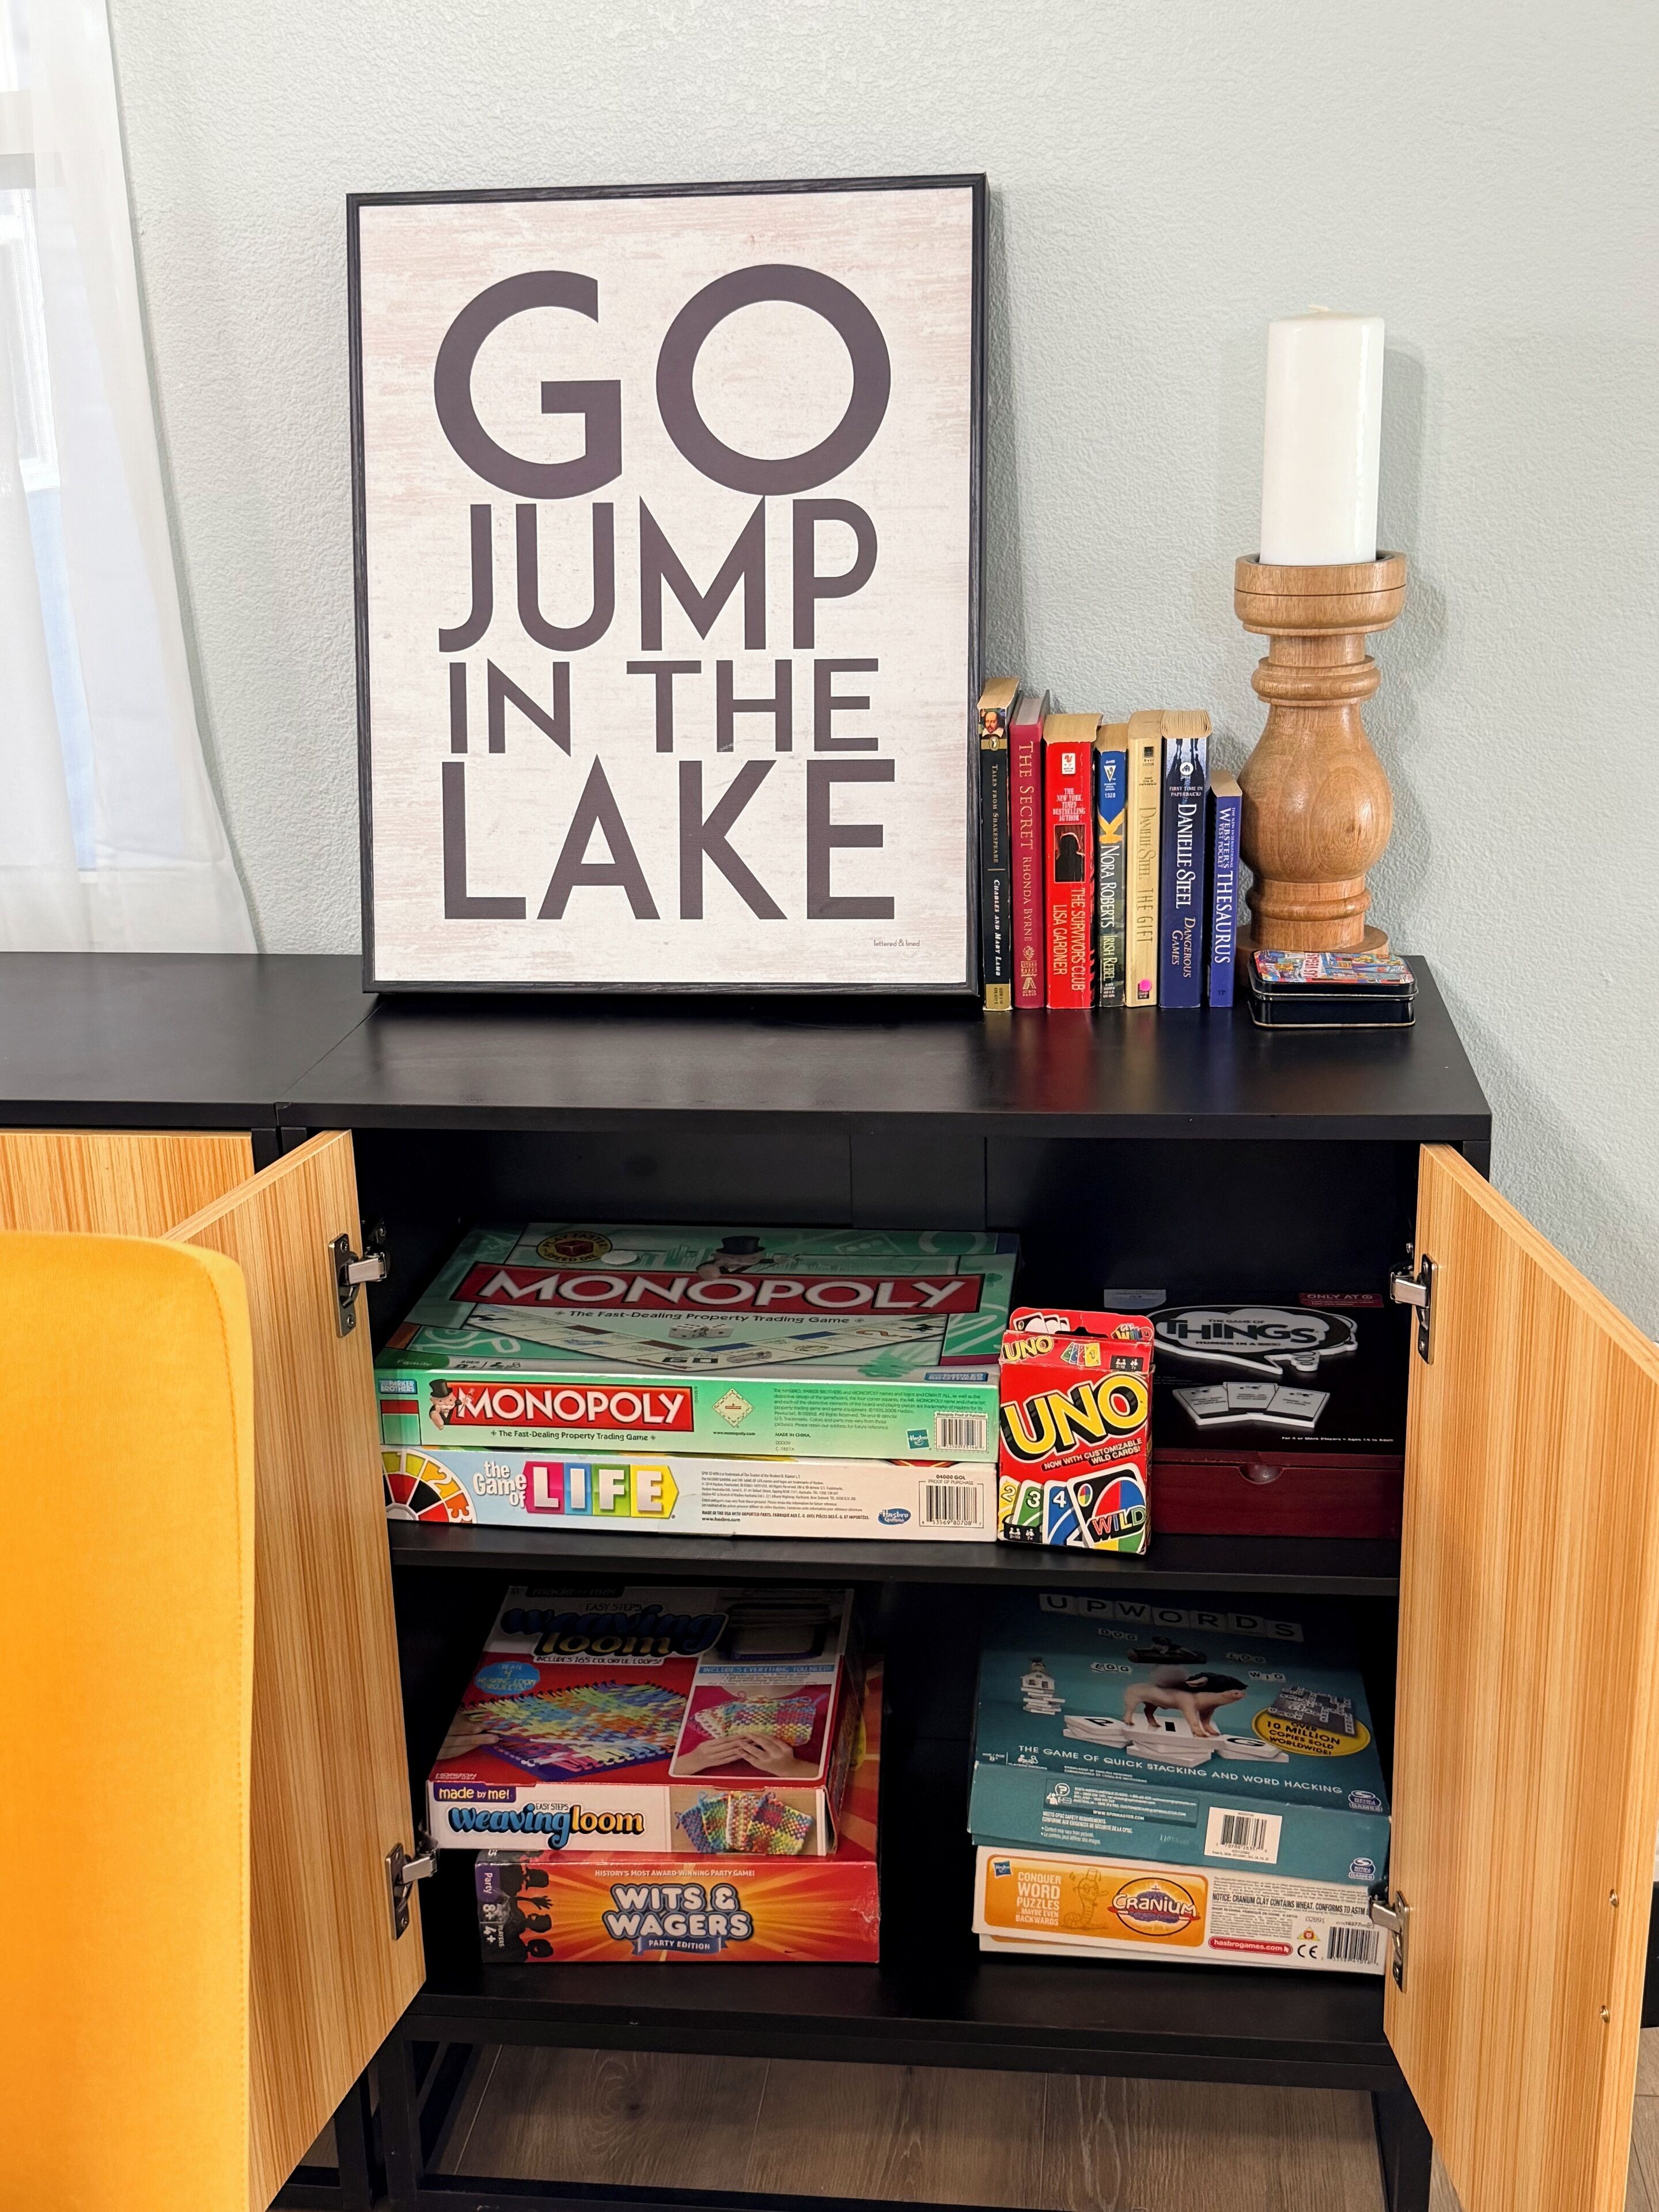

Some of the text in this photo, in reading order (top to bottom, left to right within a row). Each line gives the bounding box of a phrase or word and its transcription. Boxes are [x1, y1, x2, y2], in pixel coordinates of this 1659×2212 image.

[434, 263, 891, 501] GO
[438, 495, 878, 653] JUMP
[449, 658, 879, 757] IN THE
[1019, 741, 1034, 850] THE SECRET
[442, 755, 896, 920] LAKE
[1176, 804, 1197, 909] DANIELLE STEEL
[1100, 845, 1120, 929] NORA ROBERTS
[1215, 808, 1233, 964] WEBSTER'S THESAURUS
[1022, 856, 1033, 941] RHONDA BYRNE
[1053, 904, 1067, 975] LISA GARDNER
[1071, 888, 1086, 991] THE SURVIVORS CLUB
[1103, 935, 1117, 956] IRISH
[1172, 930, 1183, 965] GAMES
[1183, 917, 1196, 978] DANGEROUS
[1103, 957, 1117, 981] REBEL
[478, 1270, 966, 1309] MONOPOLY
[597, 1311, 682, 1320] Fast-Dealing
[685, 1312, 749, 1323] Property
[752, 1315, 805, 1323] Trading
[808, 1316, 850, 1324] Game
[1166, 1319, 1317, 1343] THINGS
[1004, 1336, 1052, 1361] UNO
[457, 1387, 684, 1424] MONOPOLY
[1003, 1374, 1148, 1456] UNO
[498, 1429, 649, 1442] The Fast-Dealing Property Trading Game
[1044, 1438, 1143, 1470] NOW WITH CUSTOMIZABLE
[1092, 1446, 1141, 1465] WILD CARDS!
[484, 1460, 510, 1478] the
[472, 1472, 527, 1495] Game
[532, 1466, 663, 1512] LIFE
[1001, 1485, 1016, 1502] 2
[509, 1491, 525, 1508] of
[1027, 1491, 1041, 1508] 3
[1053, 1490, 1066, 1508] 4
[880, 1509, 908, 1518] Hasbro
[1092, 1507, 1146, 1535] WILD
[585, 1603, 609, 1611] EASY
[1047, 1596, 1297, 1638] UPWORDS
[542, 1632, 671, 1655] loom
[1267, 1721, 1340, 1745] 10 MILLION
[1291, 1722, 1317, 1732] OVER
[1269, 1730, 1334, 1749] COPIES SOLD
[1270, 1736, 1331, 1755] WORLDWIDE!
[1018, 1745, 1039, 1753] THE
[1043, 1748, 1079, 1759] GAME
[1103, 1757, 1143, 1769] QUICK
[1147, 1763, 1207, 1777] STACKING
[1211, 1771, 1238, 1781] AND
[1243, 1774, 1279, 1786] WORD
[1285, 1781, 1343, 1794] HACKING
[438, 1787, 474, 1800] made
[488, 1789, 509, 1800] me!
[1093, 1810, 1145, 1821] WWW.SPINMASTER.COM
[483, 1873, 493, 1894] Party
[1018, 1872, 1061, 1885] CONQUER
[1018, 1881, 1060, 1899] WORD
[615, 1886, 736, 1910] WITS &
[1017, 1896, 1060, 1911] PUZZLES
[1212, 1892, 1232, 1902] NOTICE:
[1232, 1895, 1255, 1903] CRANIUM
[1256, 1897, 1269, 1905] CLAY
[1270, 1899, 1295, 1908] CONTAINS
[1296, 1902, 1314, 1910] WHEAT.
[1315, 1903, 1343, 1912] CONFORMS
[1351, 1907, 1365, 1915] ASTM
[482, 1904, 496, 1921] 8+
[1016, 1914, 1059, 1926] BACKWARDS
[483, 1926, 497, 1943] 4+
[607, 1914, 749, 1937] WAGERS
[677, 1941, 710, 1949] EDITION
[1214, 1939, 1283, 1952] hasbrogames.com
